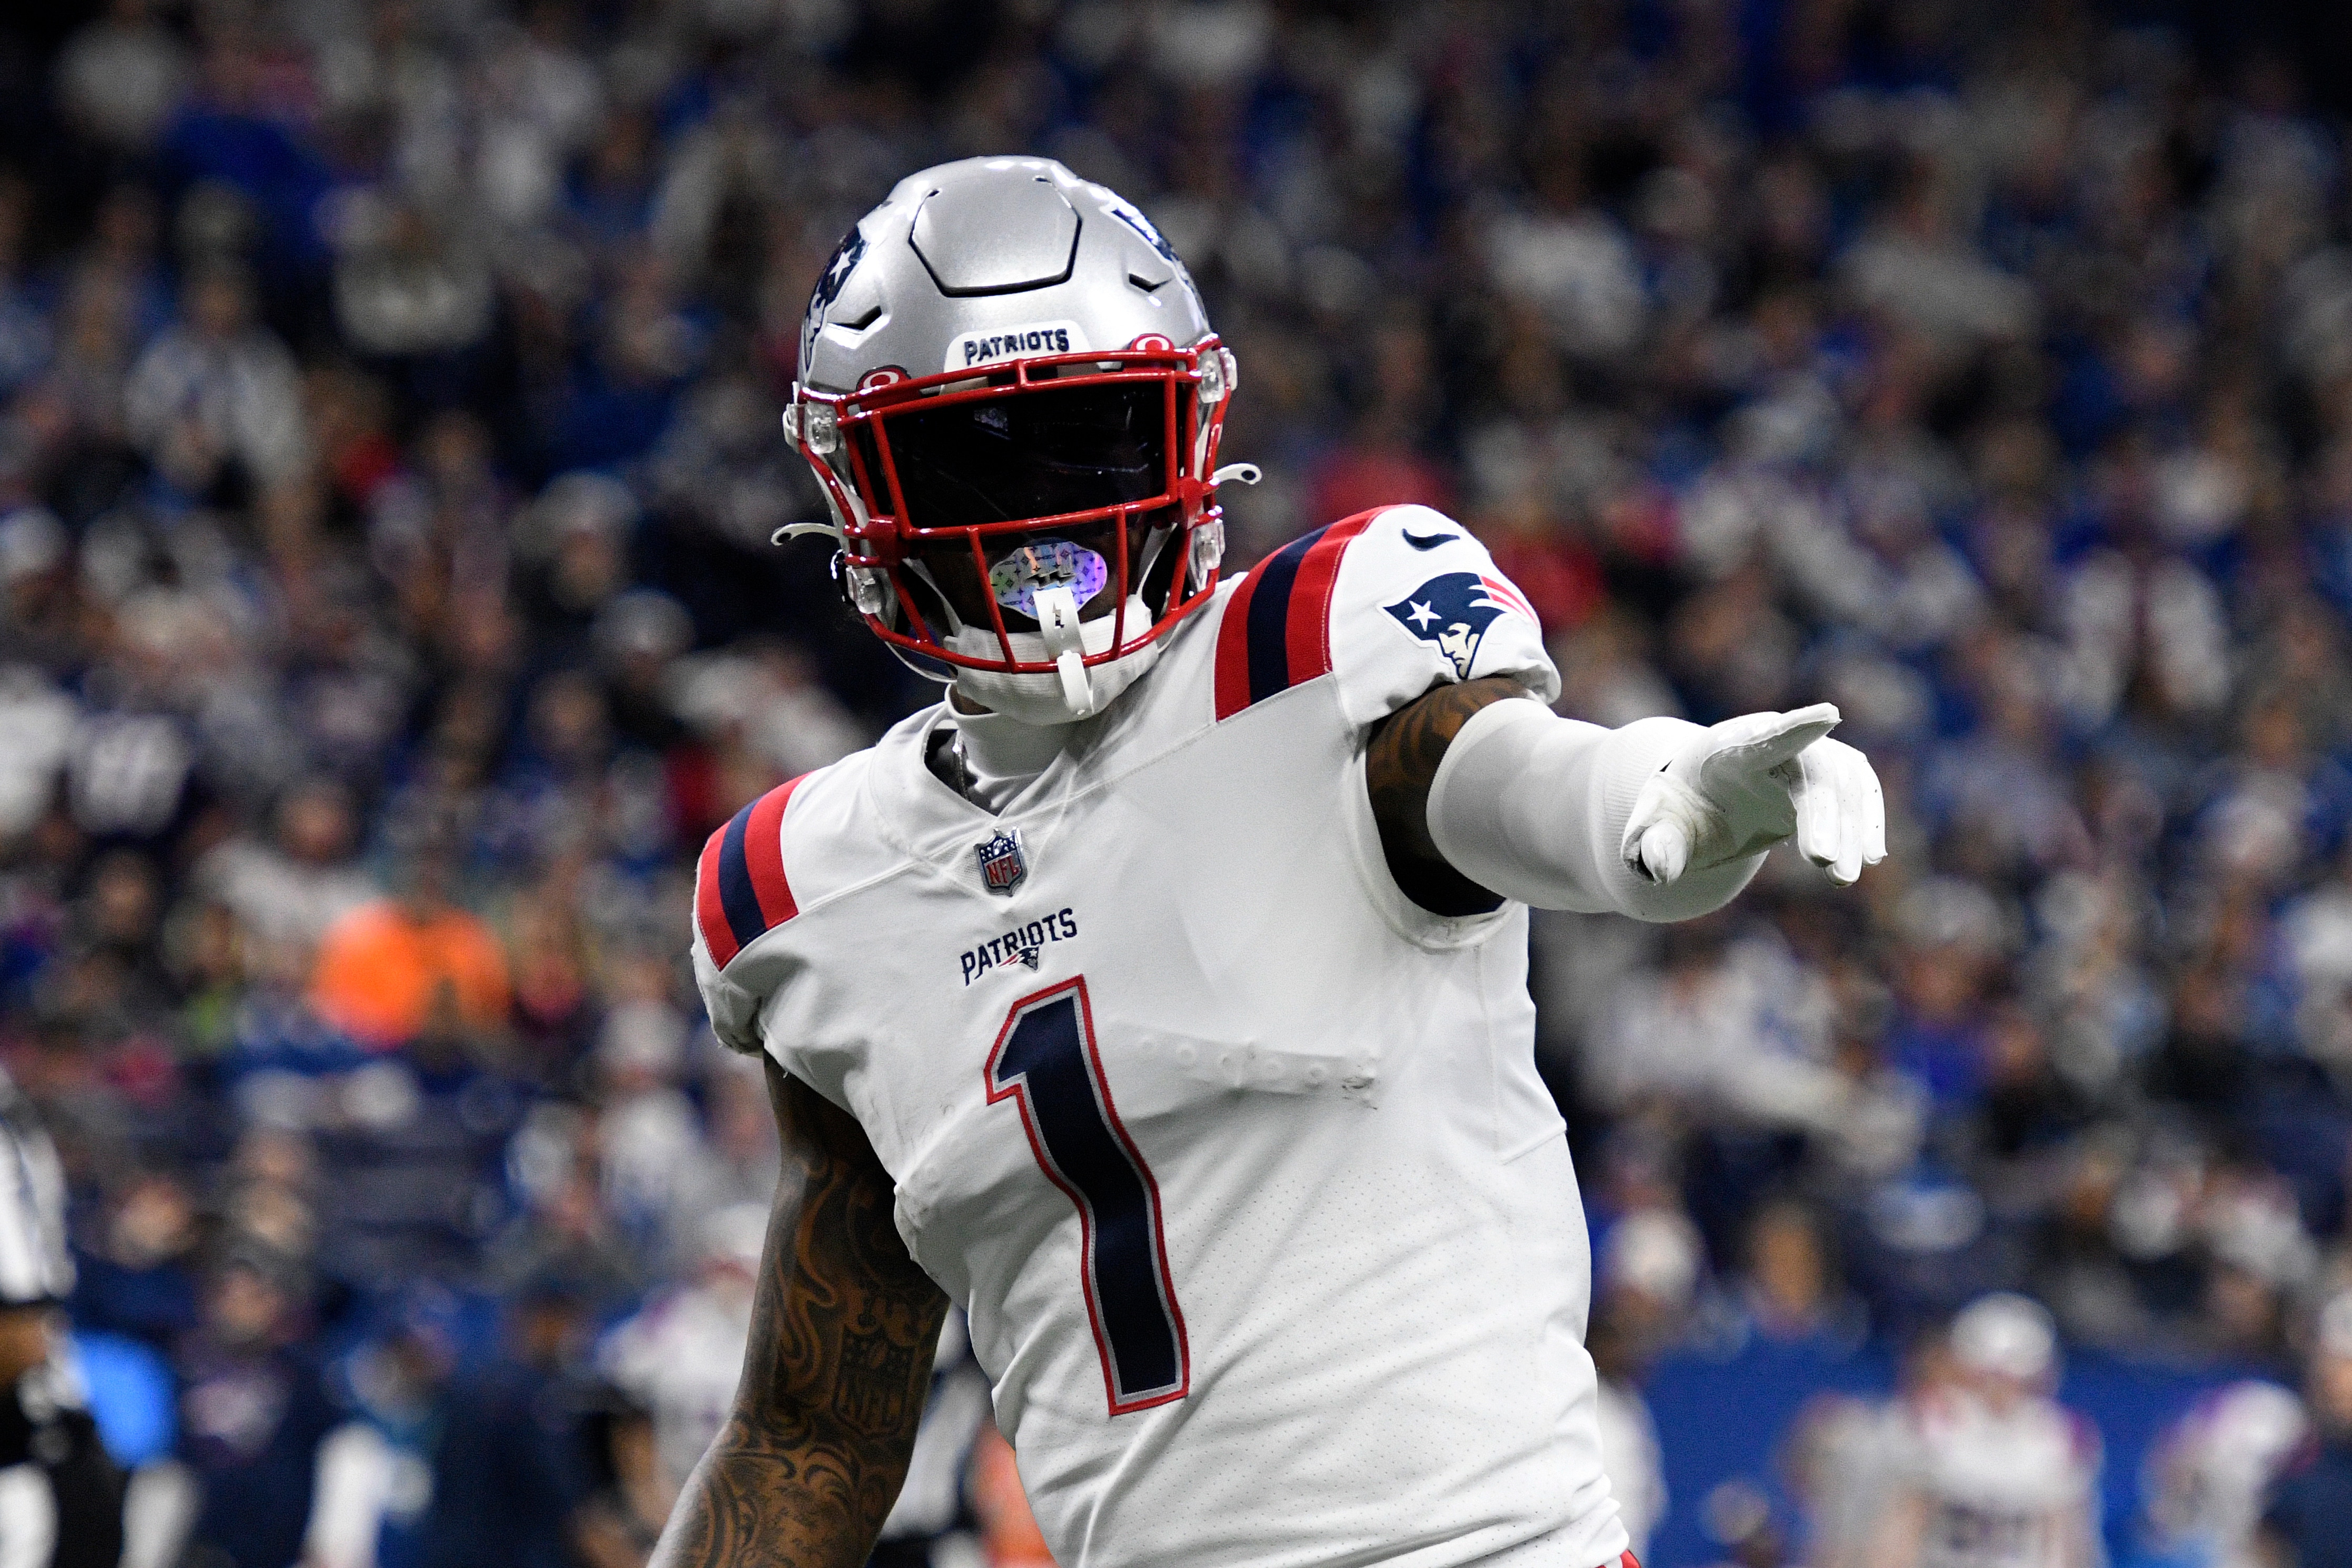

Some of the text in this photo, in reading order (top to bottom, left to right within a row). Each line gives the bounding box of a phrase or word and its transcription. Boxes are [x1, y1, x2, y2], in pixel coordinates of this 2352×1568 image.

[964, 329, 1069, 365] PATRIOTS
[986, 856, 1019, 884] NFL
[961, 908, 1077, 986] PATRIOTS
[984, 974, 1190, 1416] 1
